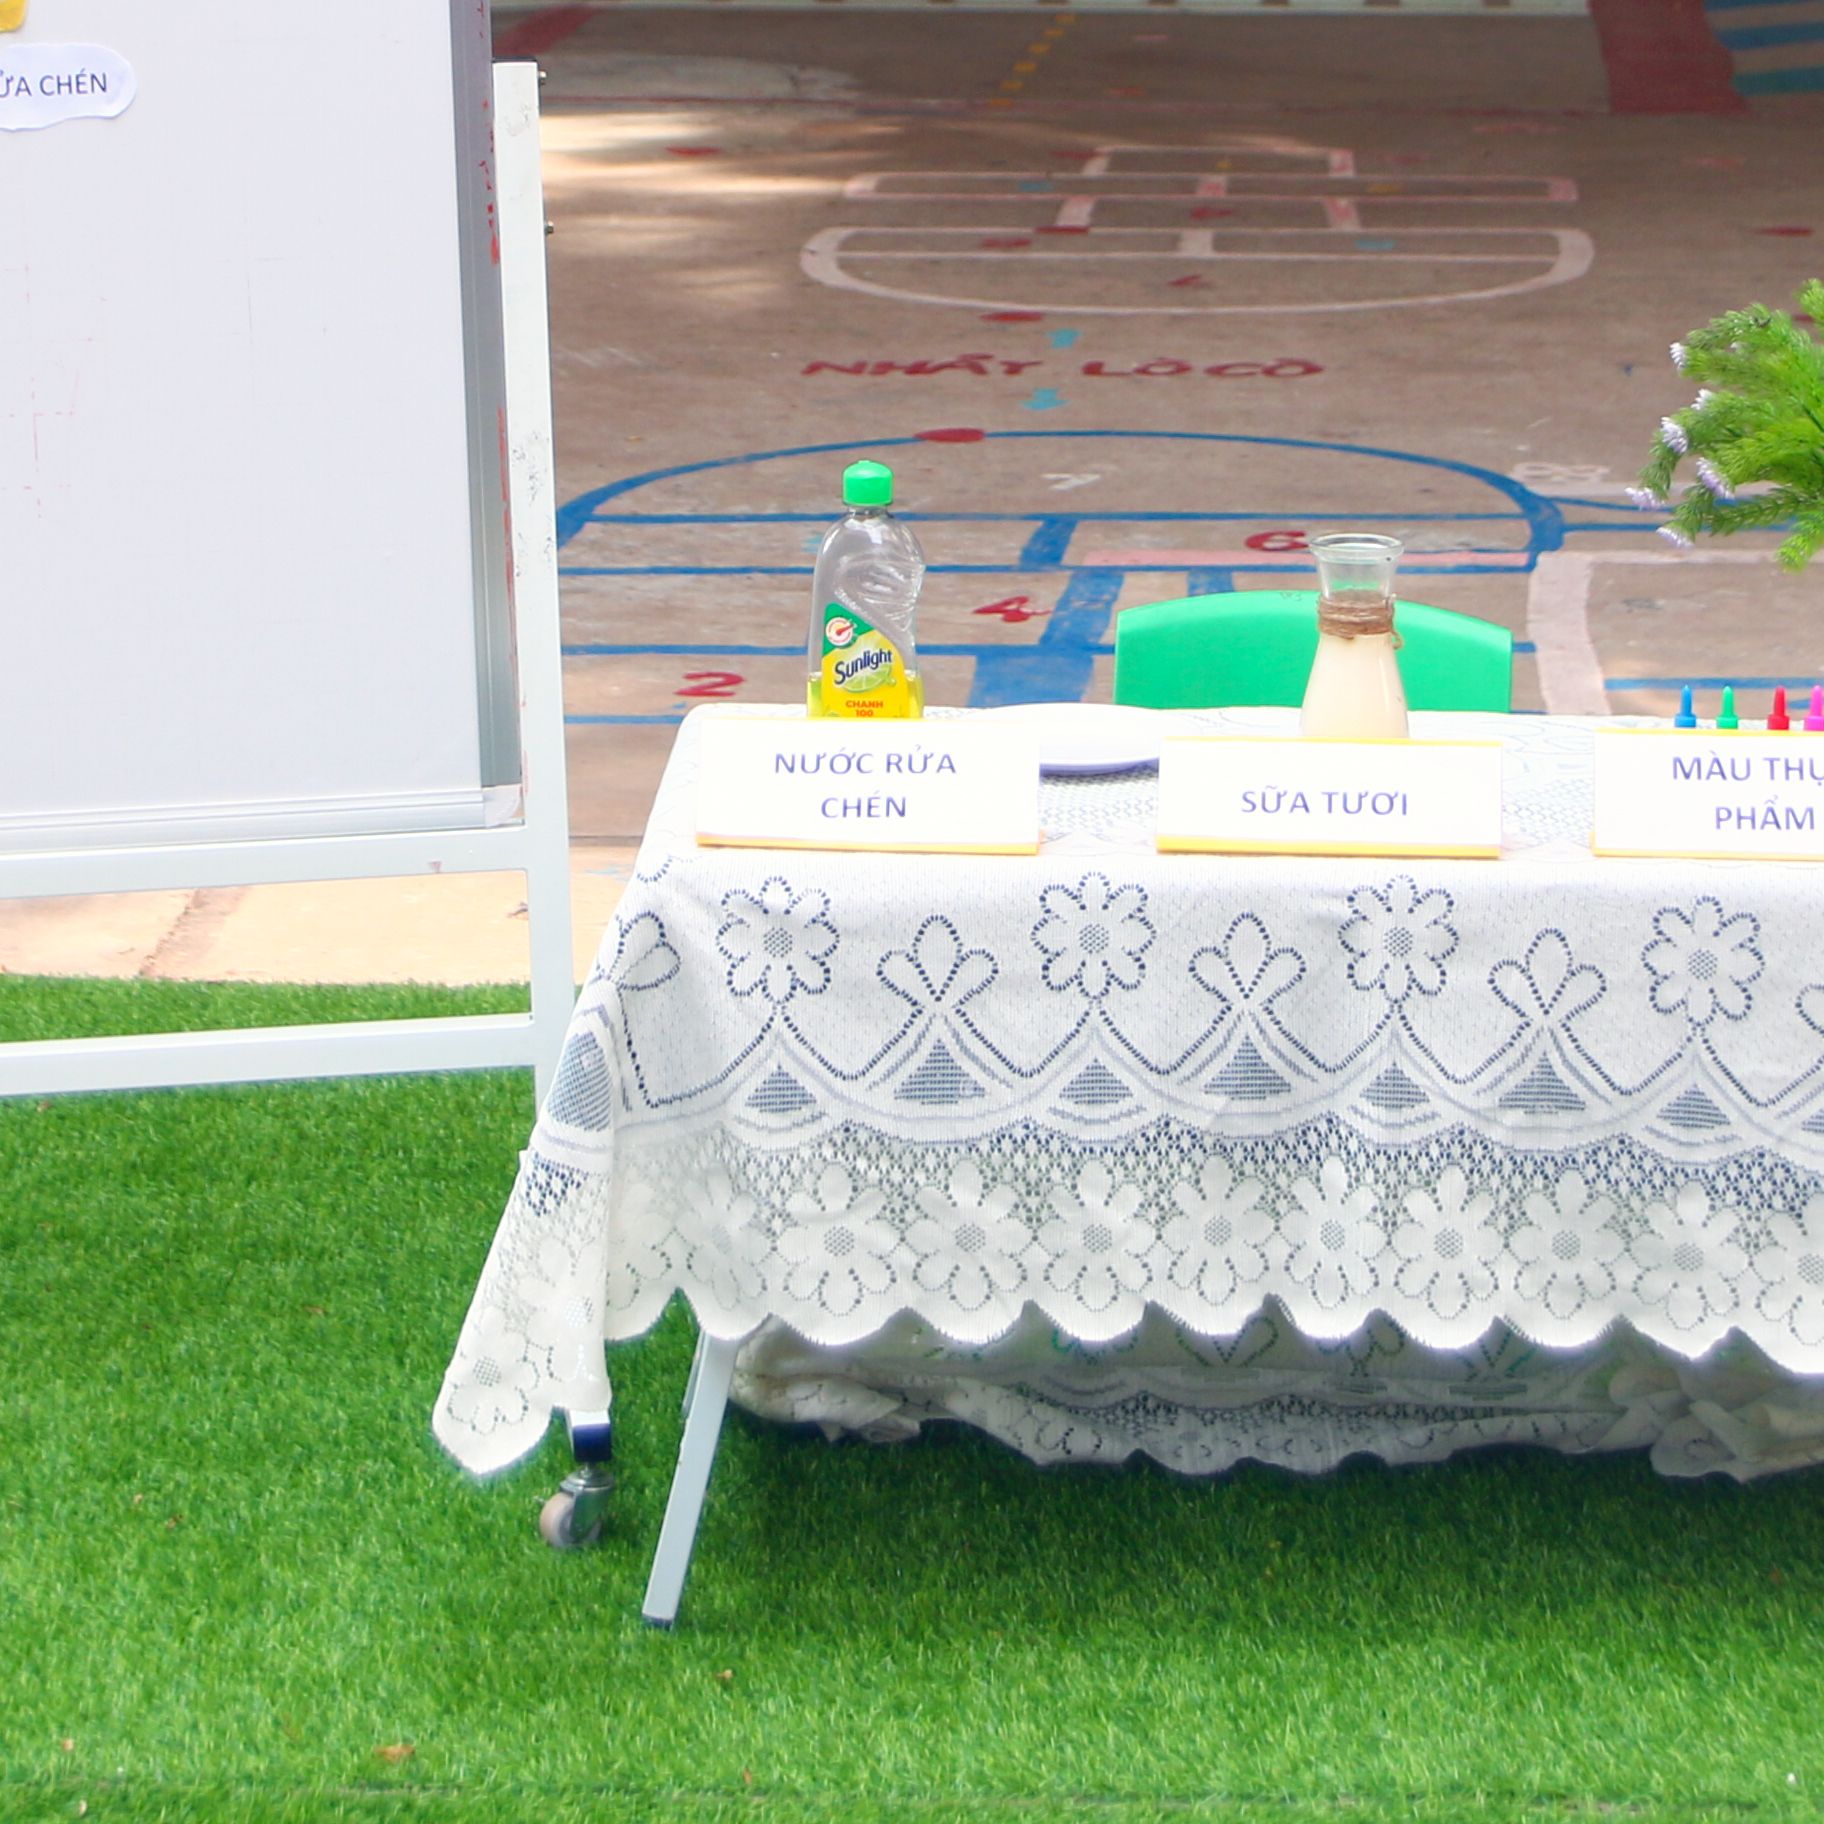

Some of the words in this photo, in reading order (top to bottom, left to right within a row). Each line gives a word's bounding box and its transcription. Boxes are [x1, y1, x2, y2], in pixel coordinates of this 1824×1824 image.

[38, 67, 108, 97] CHÉN
[833, 647, 893, 685] Sunlight
[676, 671, 745, 699] 2
[845, 699, 884, 709] CHANH
[855, 709, 874, 718] 100
[774, 746, 874, 775] NƯỚC
[885, 744, 957, 775] RỬA
[1671, 749, 1753, 782] MÀU
[819, 791, 908, 819] CHÉN
[1240, 784, 1312, 815] SỮA
[1321, 790, 1408, 817] TƯƠI
[1714, 794, 1816, 831] PHẨM
